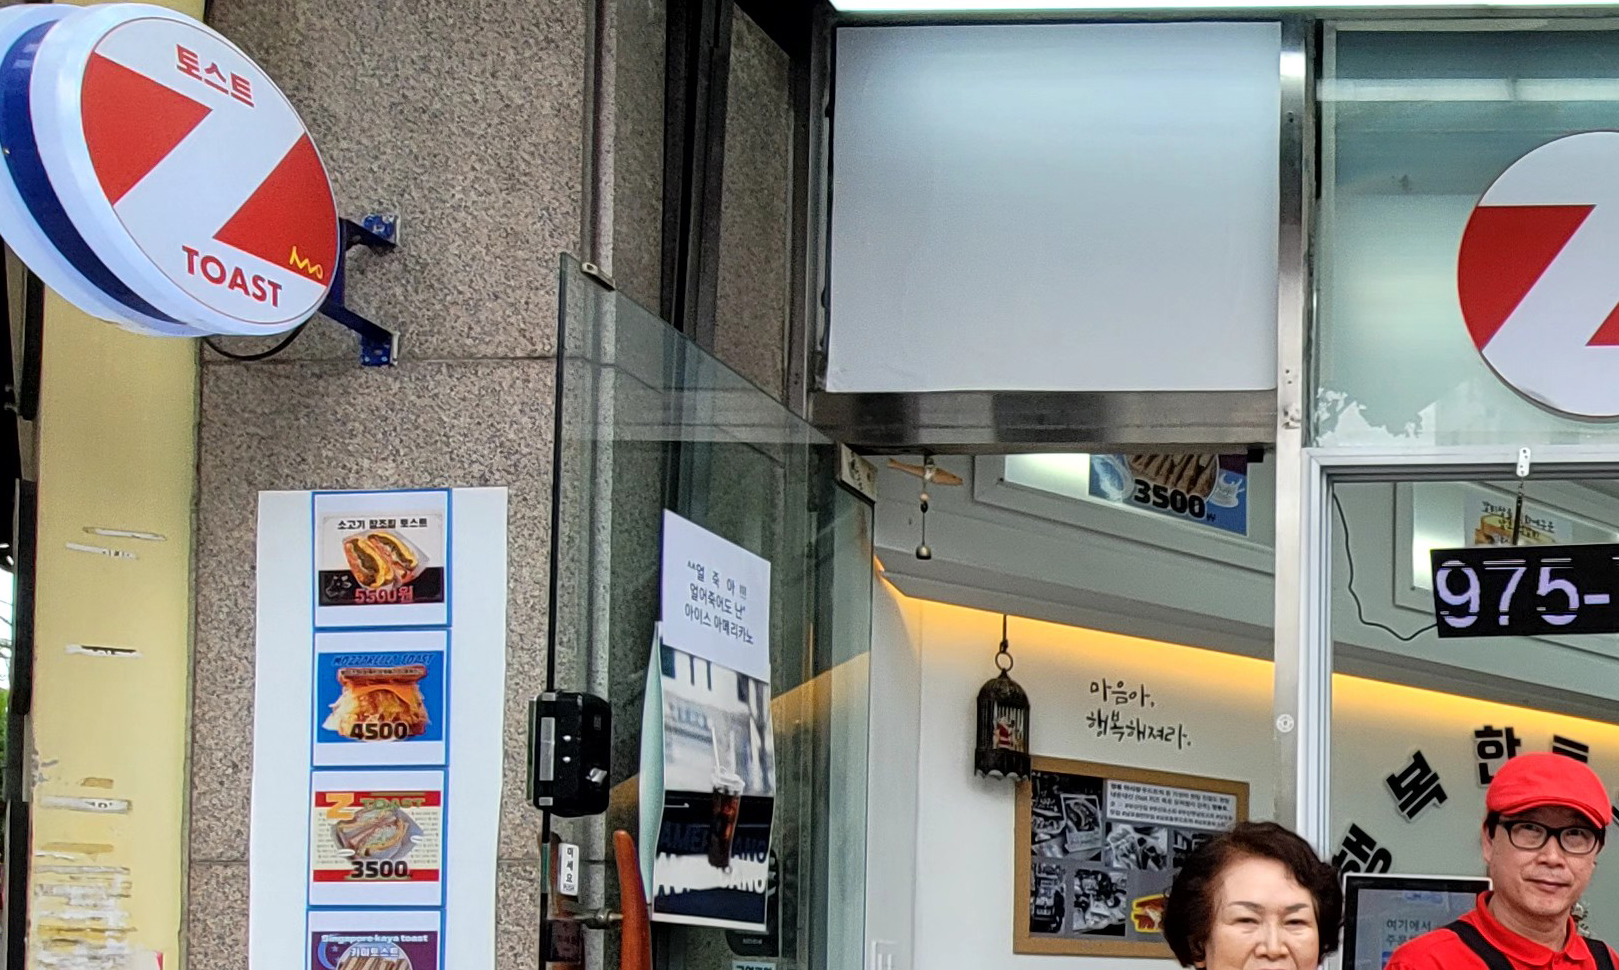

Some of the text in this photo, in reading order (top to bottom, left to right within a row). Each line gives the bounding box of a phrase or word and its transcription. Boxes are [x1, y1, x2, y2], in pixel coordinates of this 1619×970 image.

[175, 43, 255, 108] 토스트
[181, 244, 283, 308] TOAST
[1133, 479, 1207, 520] 3500
[337, 520, 366, 530] 소고기
[400, 518, 428, 528] 토스트
[689, 582, 733, 615] 얼어죽어도
[684, 602, 755, 646] 아이스 아메리카노
[349, 721, 408, 740] 4500
[351, 860, 408, 879] 3500
[1386, 918, 1432, 932] 여기에서
[400, 934, 429, 943] toast
